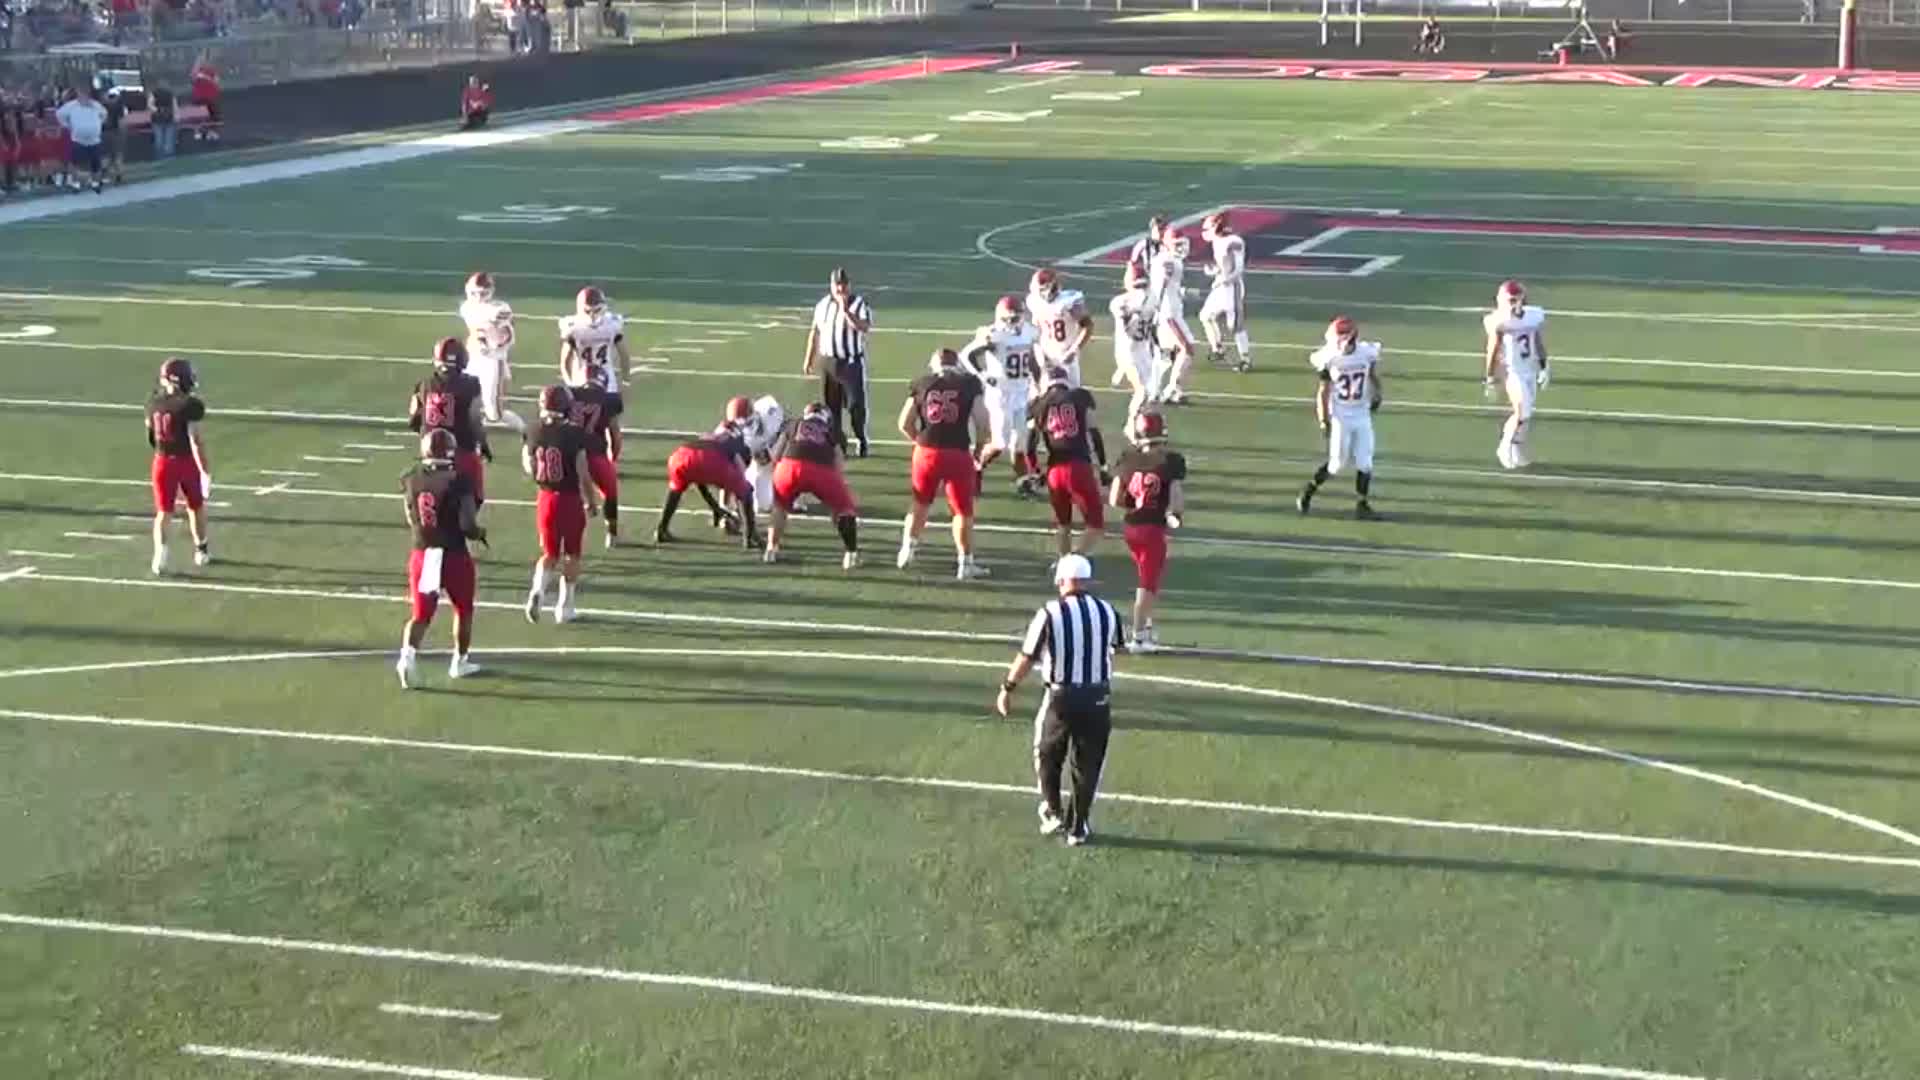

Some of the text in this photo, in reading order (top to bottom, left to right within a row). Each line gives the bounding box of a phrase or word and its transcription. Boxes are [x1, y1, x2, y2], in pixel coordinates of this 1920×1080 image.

[581, 344, 609, 365] 44
[1519, 334, 1531, 359] 3
[1338, 372, 1365, 401] 37
[926, 389, 959, 425] 65
[1128, 471, 1161, 509] 42
